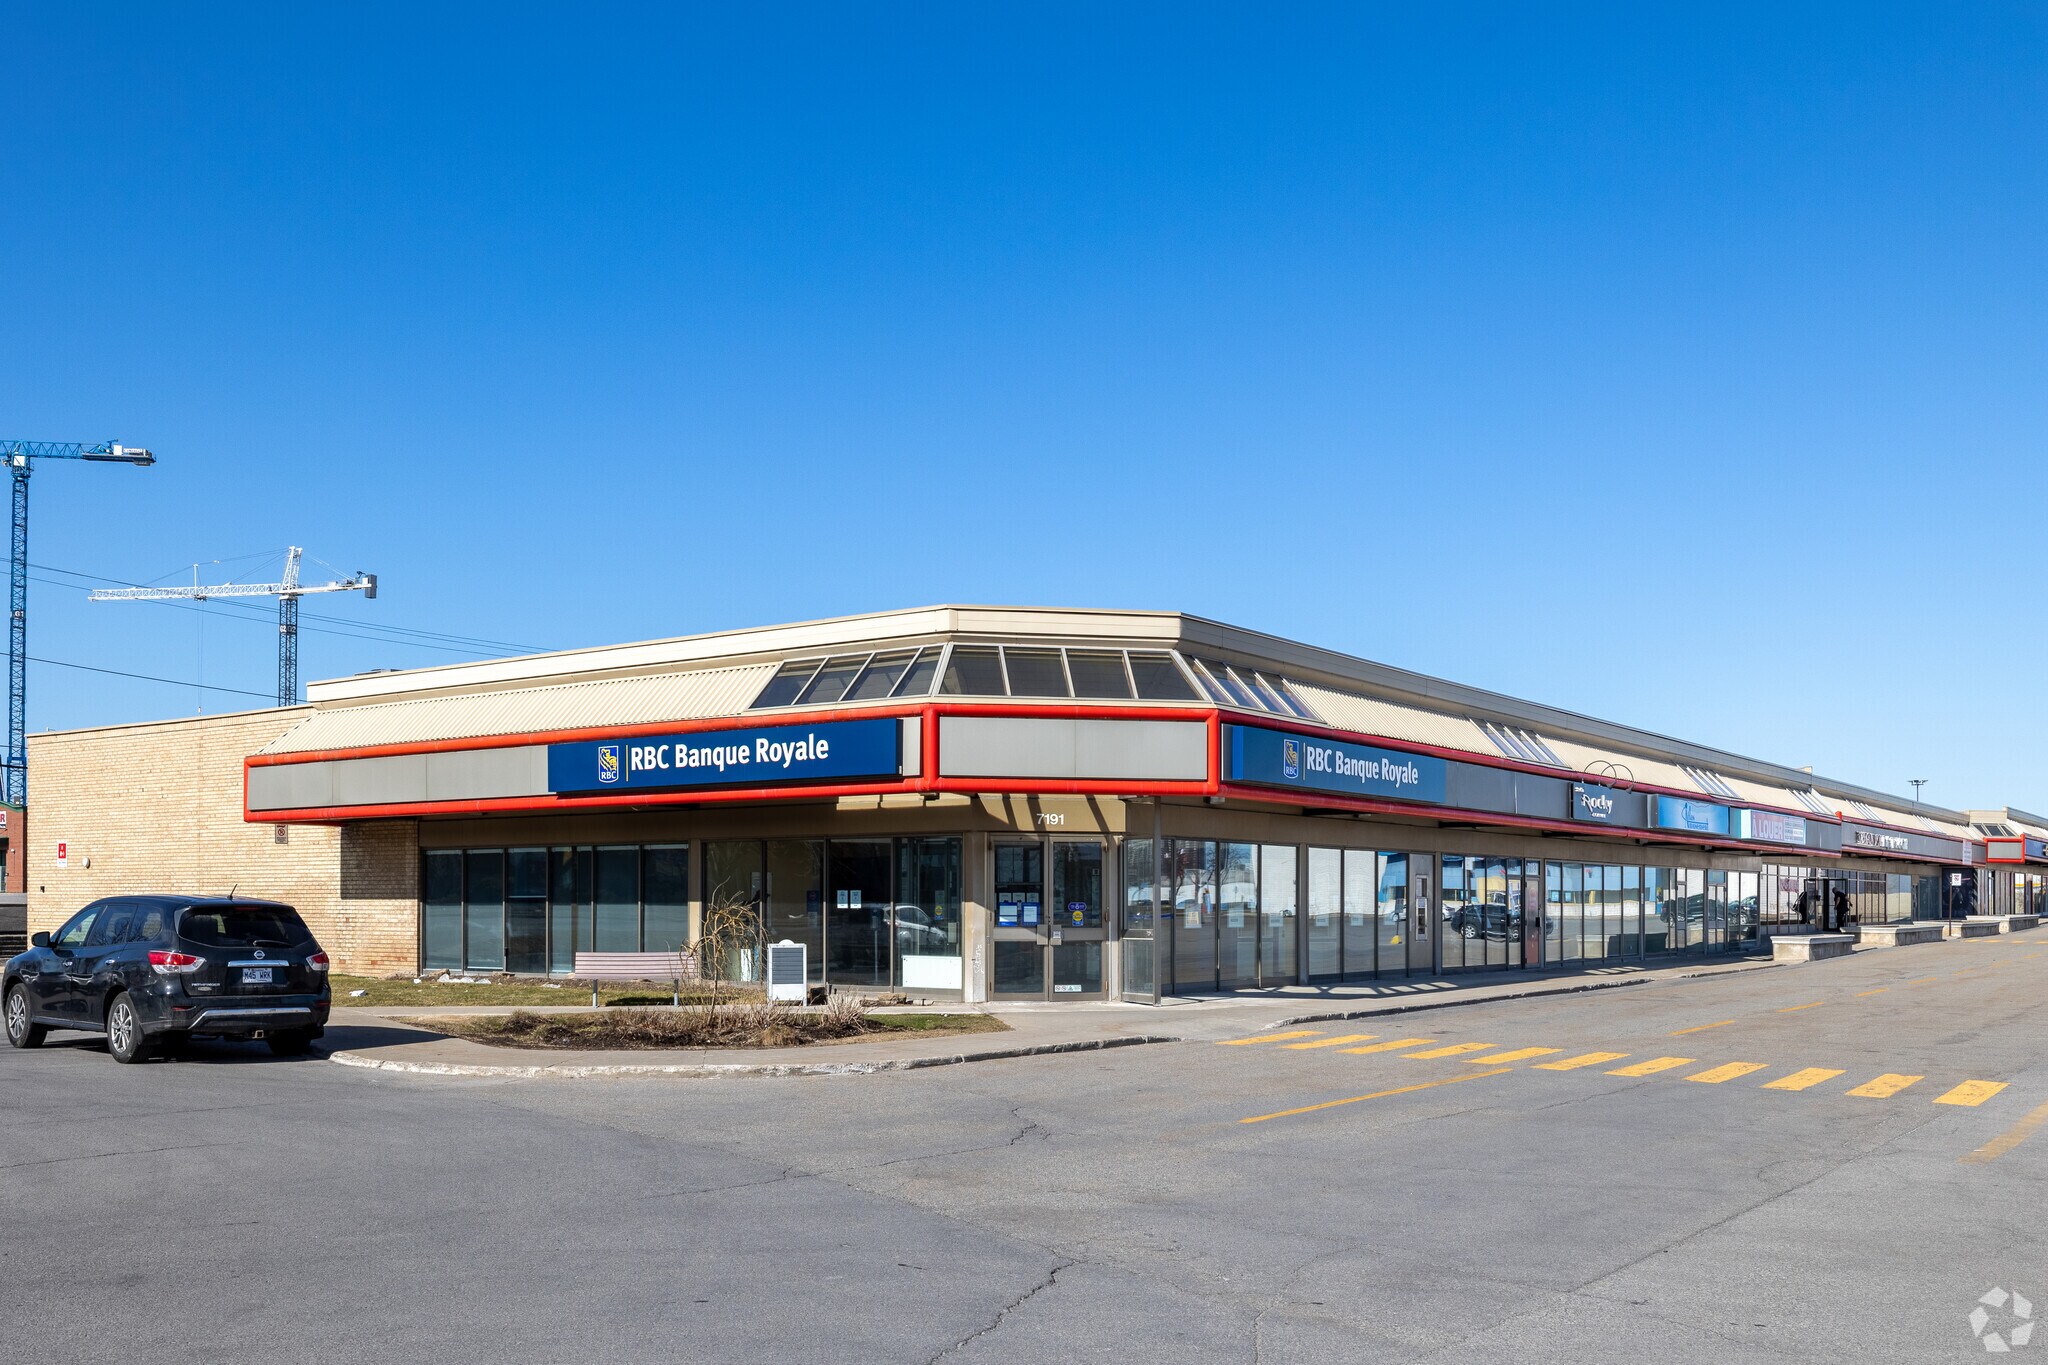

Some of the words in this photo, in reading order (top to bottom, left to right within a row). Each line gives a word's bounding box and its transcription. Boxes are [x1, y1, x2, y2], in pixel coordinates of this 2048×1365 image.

[631, 745, 670, 771] RBC
[675, 743, 750, 773] Banque
[755, 733, 829, 769] Royale
[1285, 766, 1297, 776] RBC
[1306, 746, 1333, 773] RBC
[1335, 750, 1380, 784] Banque
[1381, 757, 1419, 788] Royale
[601, 771, 617, 780] RBC
[1036, 813, 1065, 825] 7191
[1758, 818, 1784, 841] LOUER
[244, 971, 257, 980] M45
[259, 971, 272, 979] WRK
